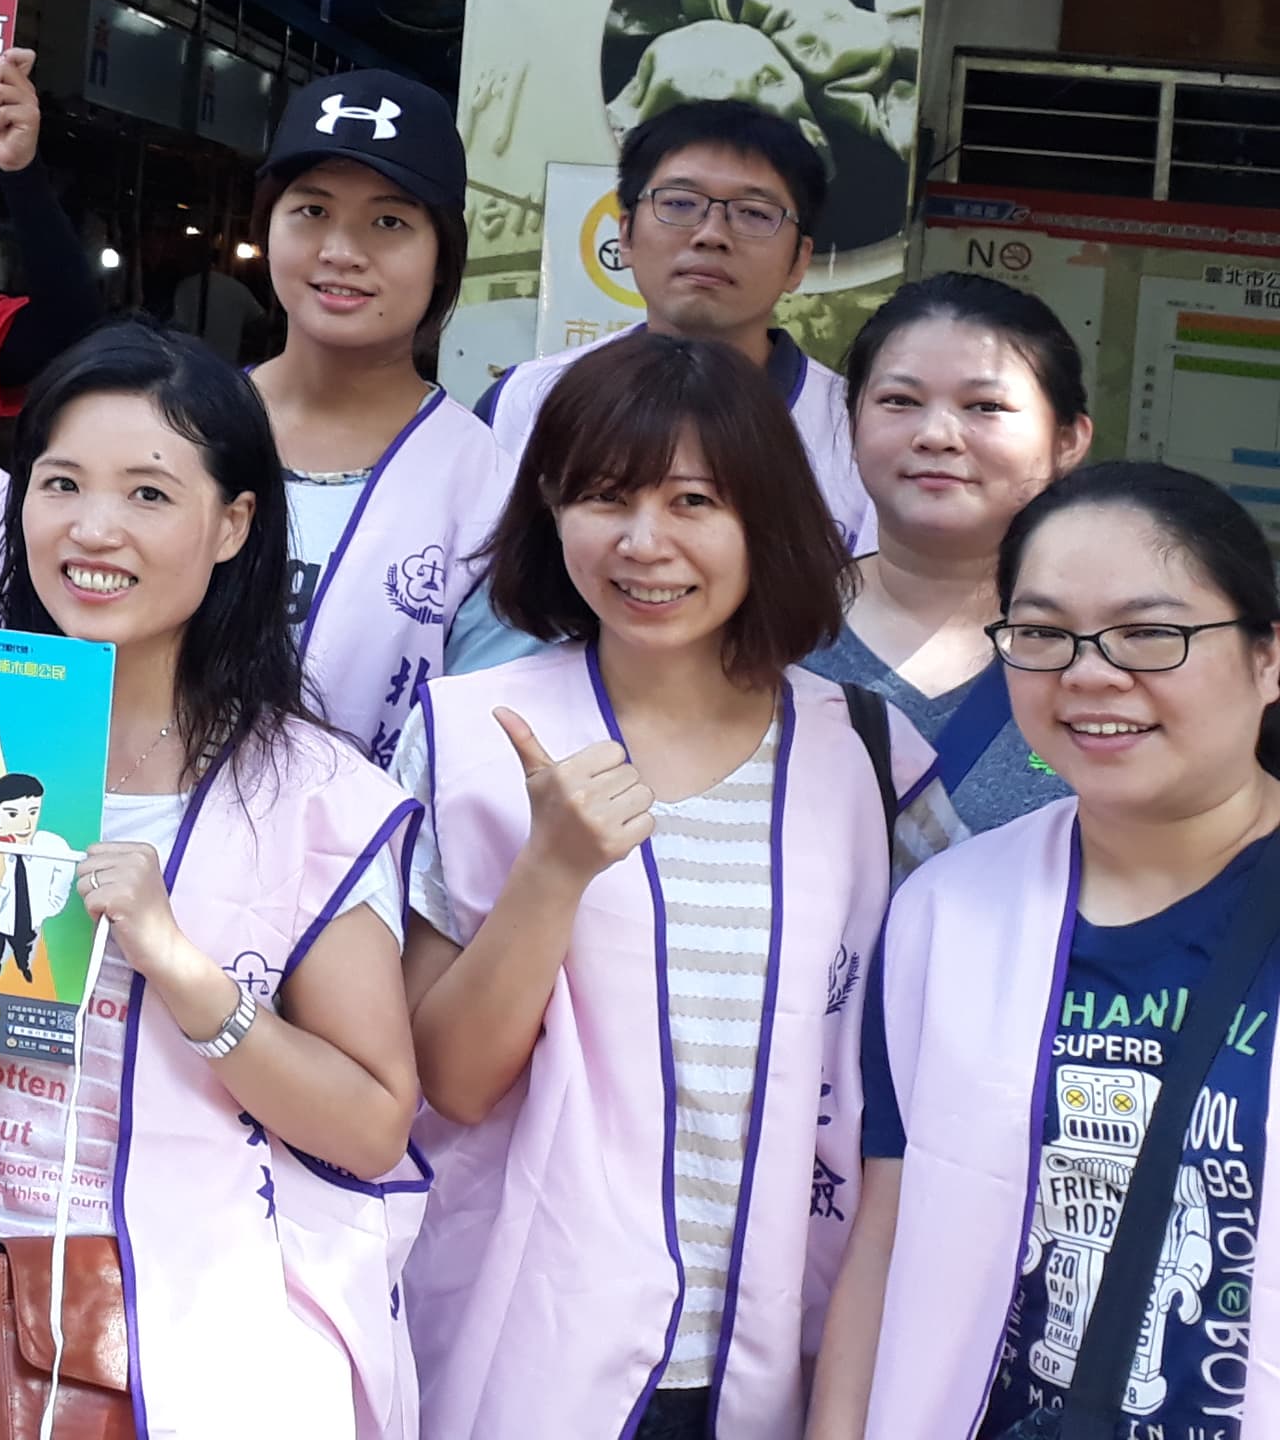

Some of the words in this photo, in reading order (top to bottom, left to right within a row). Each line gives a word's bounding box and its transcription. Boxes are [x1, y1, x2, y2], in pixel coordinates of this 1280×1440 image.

[1052, 1033, 1163, 1065] SUPERB
[1183, 1086, 1243, 1152] OOL
[1050, 1176, 1123, 1211] FRIEN
[1064, 1204, 1116, 1248] ROB
[1048, 1252, 1075, 1280] 30
[1047, 1326, 1079, 1348] AMMO
[1033, 1350, 1061, 1375] POP
